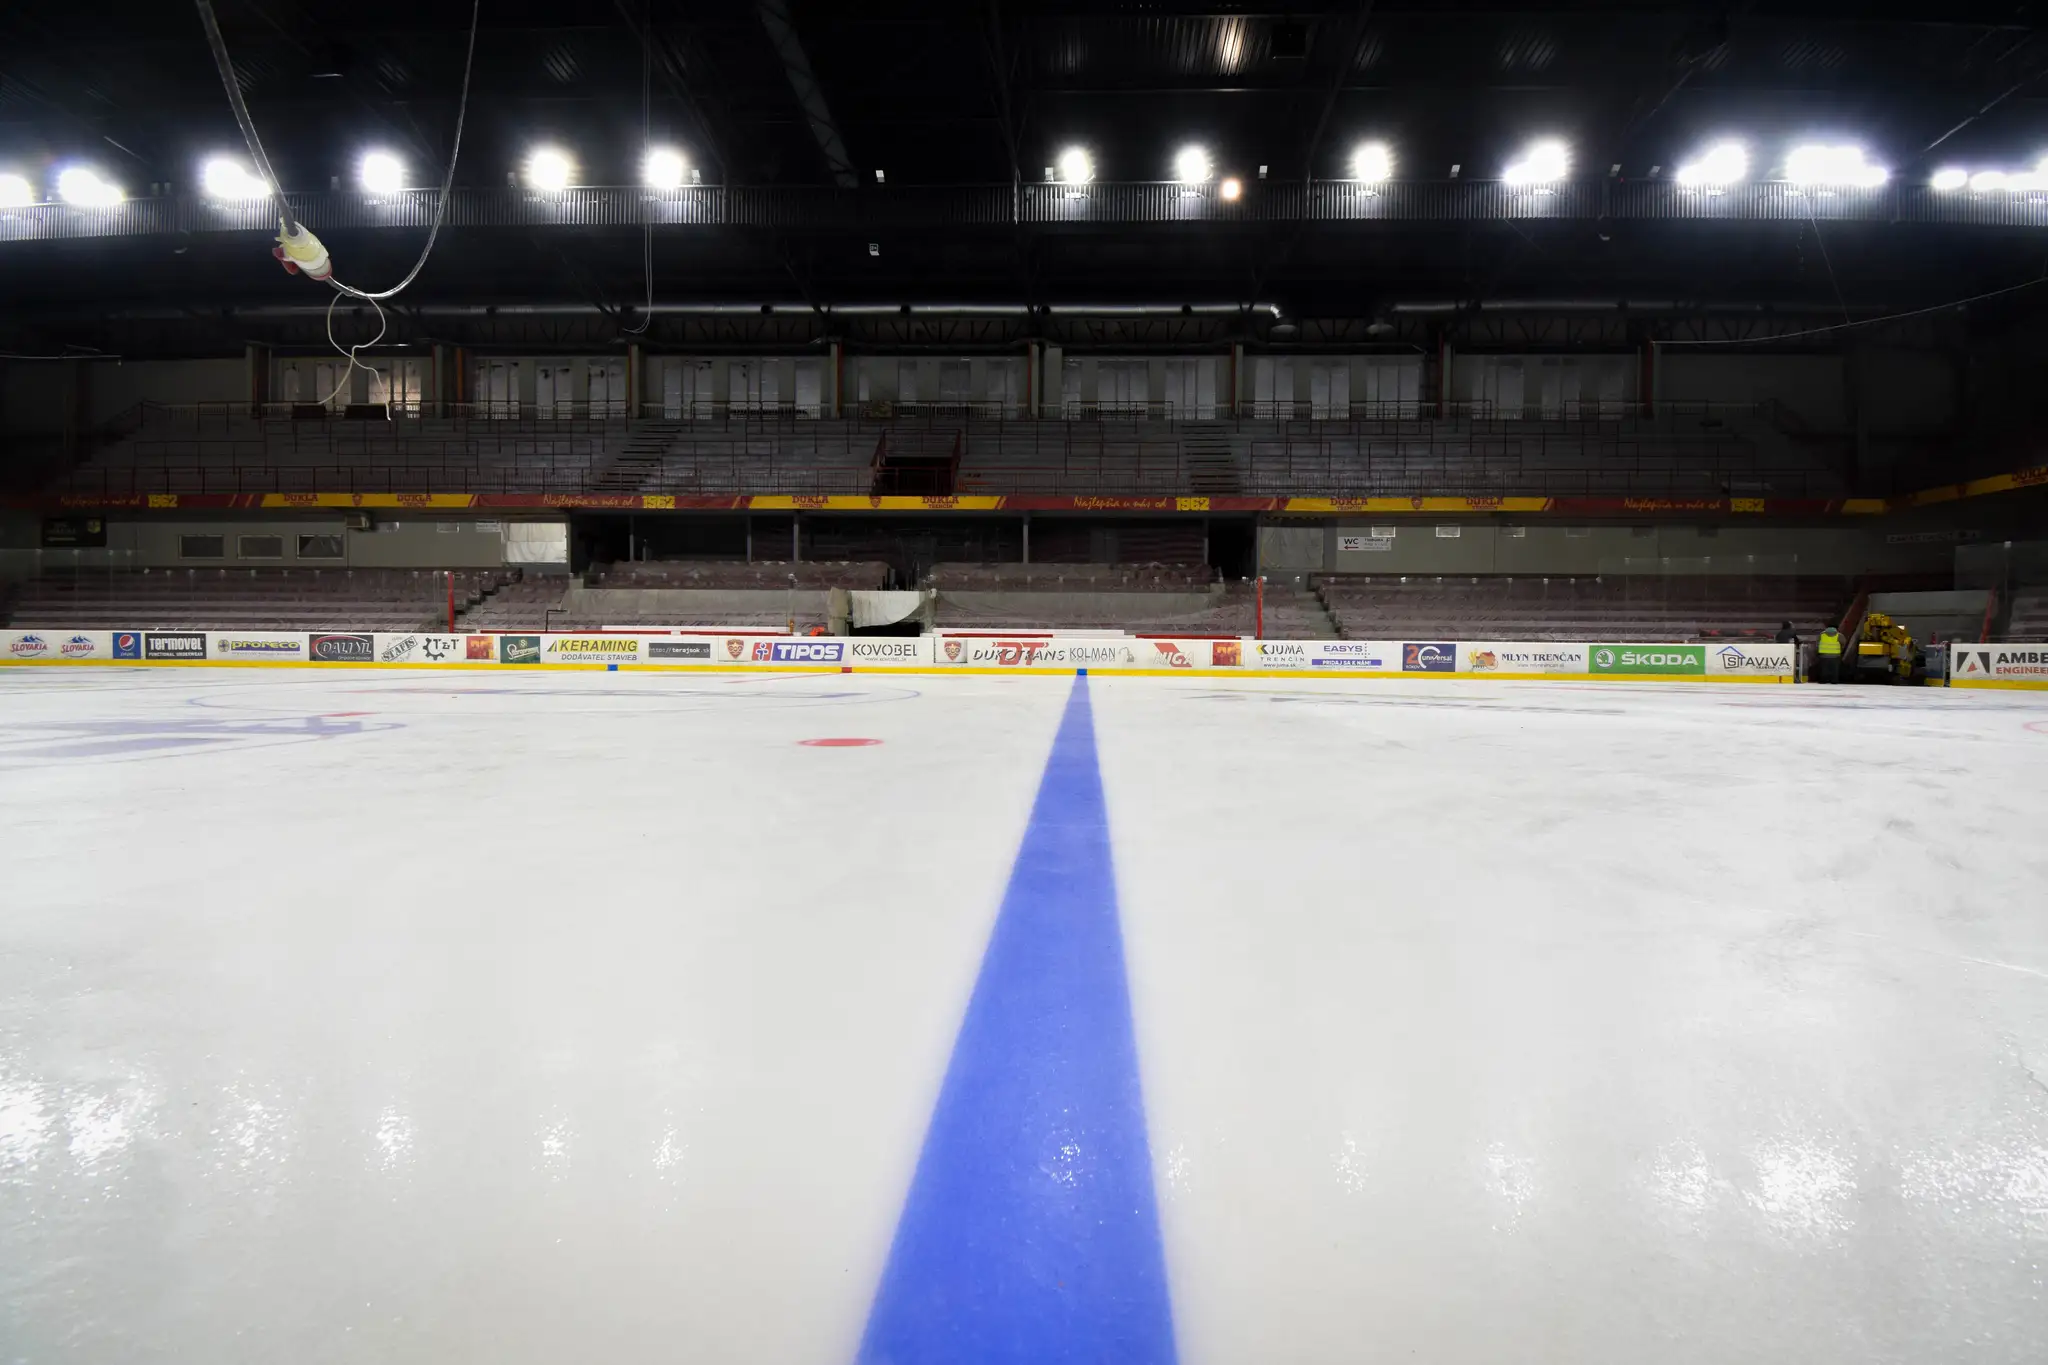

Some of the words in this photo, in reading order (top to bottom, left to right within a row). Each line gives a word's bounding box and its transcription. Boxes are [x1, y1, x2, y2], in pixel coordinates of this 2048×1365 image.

[792, 495, 829, 504] DUKLA
[922, 495, 960, 504] DUKLA
[1330, 497, 1369, 506] DUKLA
[1466, 497, 1505, 506] DUKLA
[10, 643, 48, 653] SLOVAKIA
[61, 643, 95, 654] SLOVAKIA
[231, 640, 300, 650] proreco
[433, 638, 460, 650] T&T
[560, 640, 638, 652] KERAMING
[777, 644, 840, 660] TIPOS
[852, 643, 918, 657] KOVOBEL
[973, 649, 1066, 662] DUKOTRANS
[1069, 647, 1116, 661] KOLMAN
[607, 653, 638, 661] STAVIEB
[1501, 653, 1529, 662] MLYN
[1532, 651, 1582, 662] TRENČAN
[1622, 651, 1699, 666] ŠKODA
